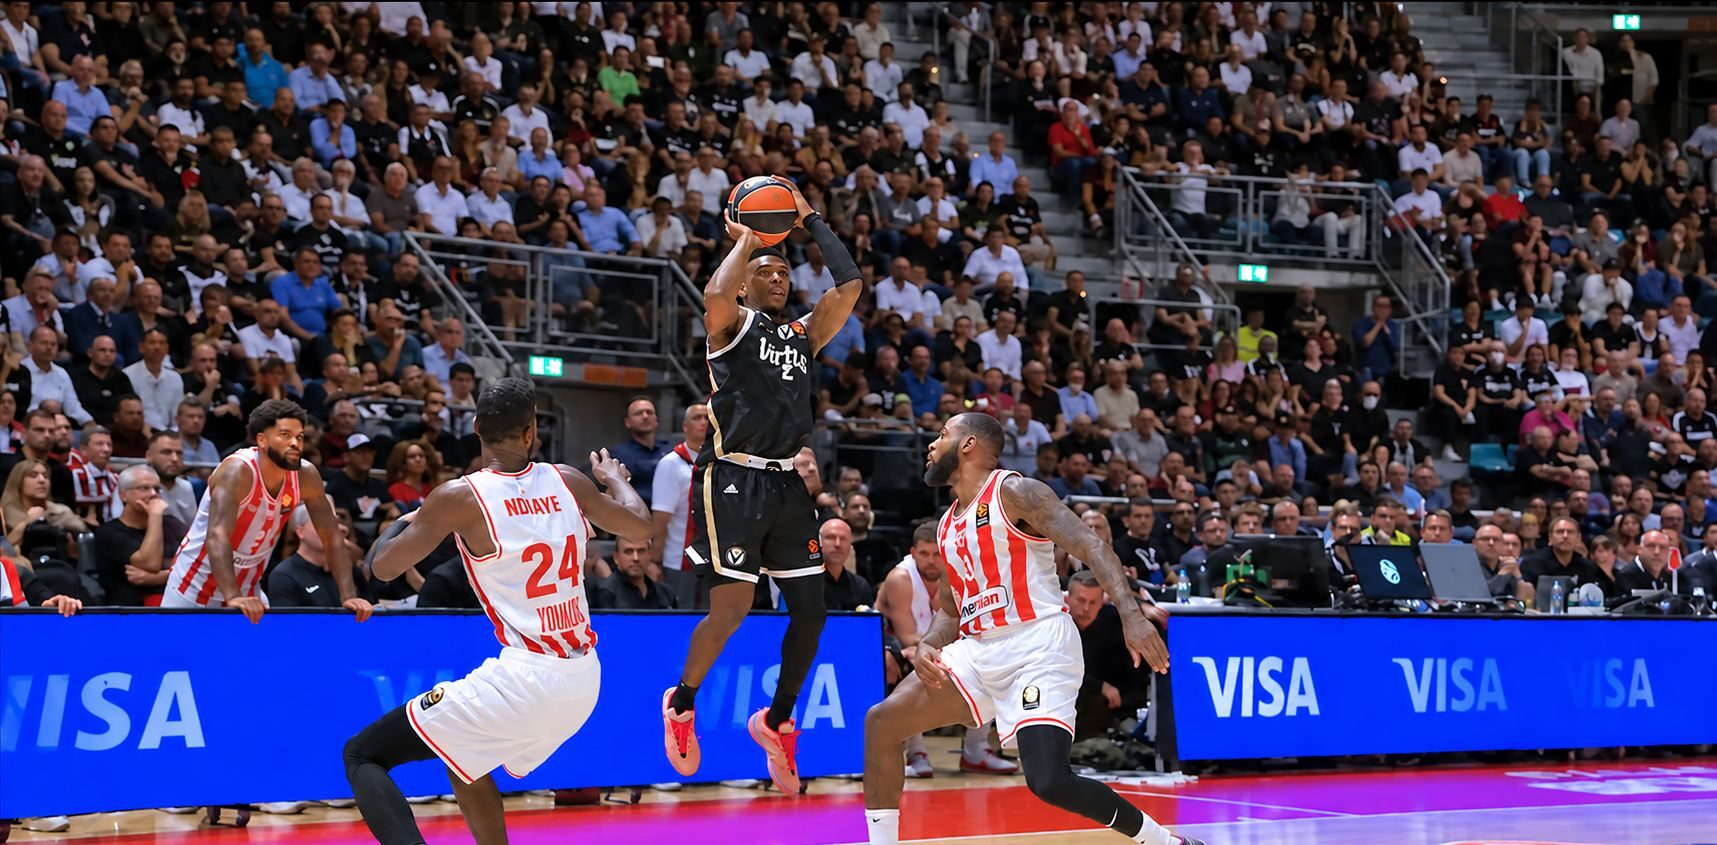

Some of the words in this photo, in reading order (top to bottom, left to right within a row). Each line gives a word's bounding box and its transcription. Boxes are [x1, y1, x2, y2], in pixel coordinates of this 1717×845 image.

[781, 364, 794, 382] 2
[503, 495, 562, 517] NDIAYE
[520, 533, 580, 600] 24
[1192, 656, 1321, 718] VISA
[1392, 657, 1509, 713] VISA
[1557, 657, 1656, 708] VISA
